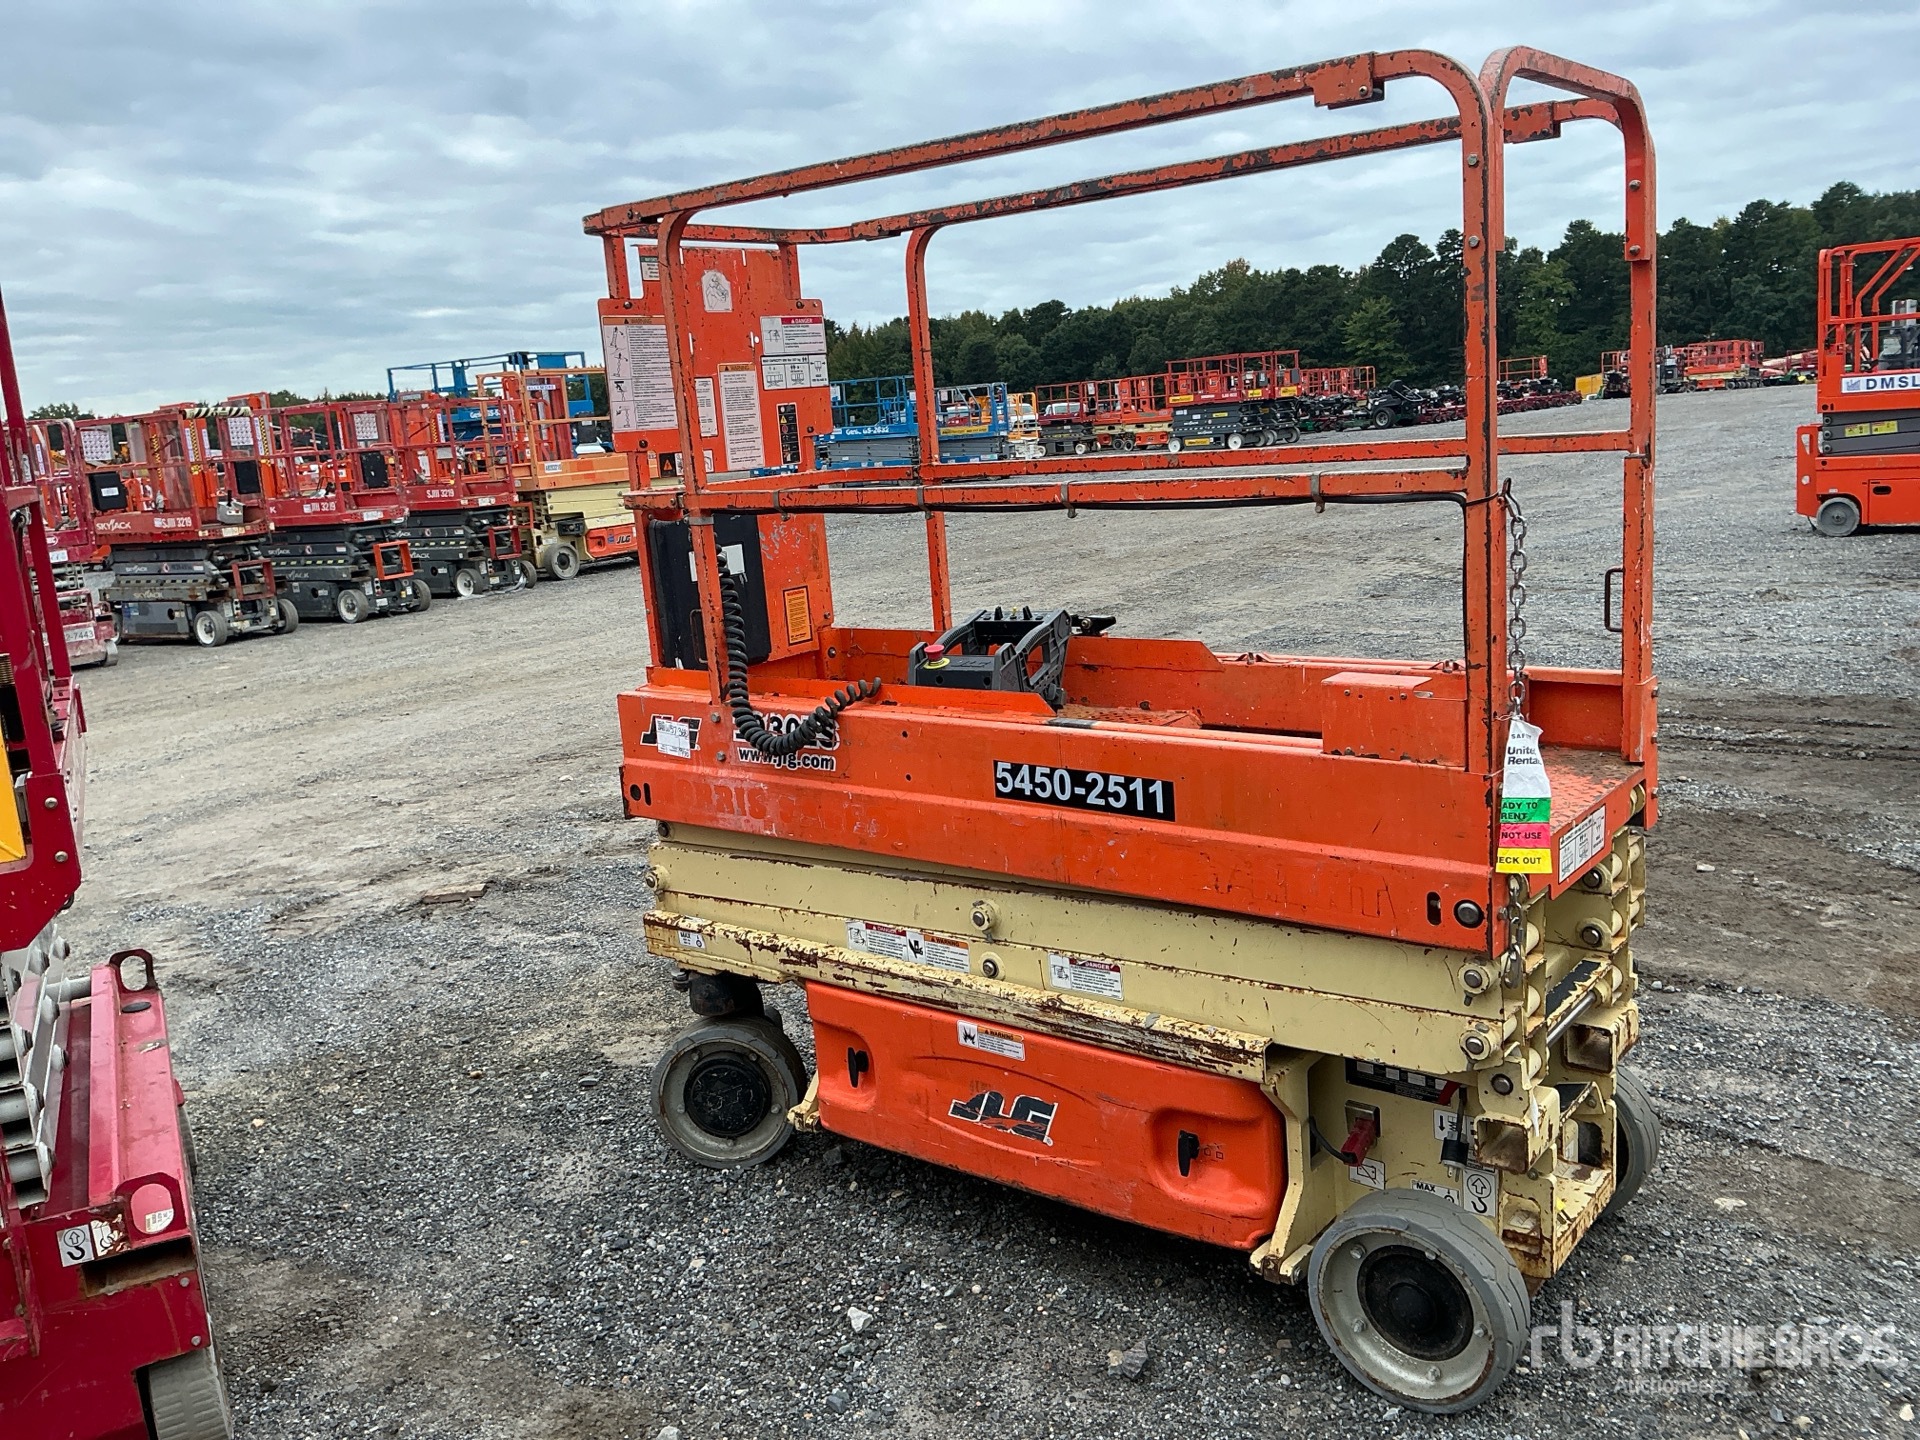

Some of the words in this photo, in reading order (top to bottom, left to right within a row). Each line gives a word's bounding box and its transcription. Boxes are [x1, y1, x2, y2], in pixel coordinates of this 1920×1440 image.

[95, 518, 131, 531] SKYJACK
[176, 516, 192, 527] 3219
[616, 535, 631, 544] JLG
[738, 747, 835, 771] www.jlg.com
[995, 761, 1165, 814] 5450-2511
[1526, 802, 1538, 810] TO
[1500, 811, 1528, 820] RENT
[1501, 831, 1522, 840] NOT
[1524, 831, 1542, 840] USE
[1522, 856, 1542, 865] OUT
[936, 937, 960, 947] WARNING
[1085, 961, 1110, 970] DANGER
[990, 1030, 1014, 1041] WARNING
[948, 1090, 1059, 1144] JLG
[1416, 1182, 1436, 1194] MAX
